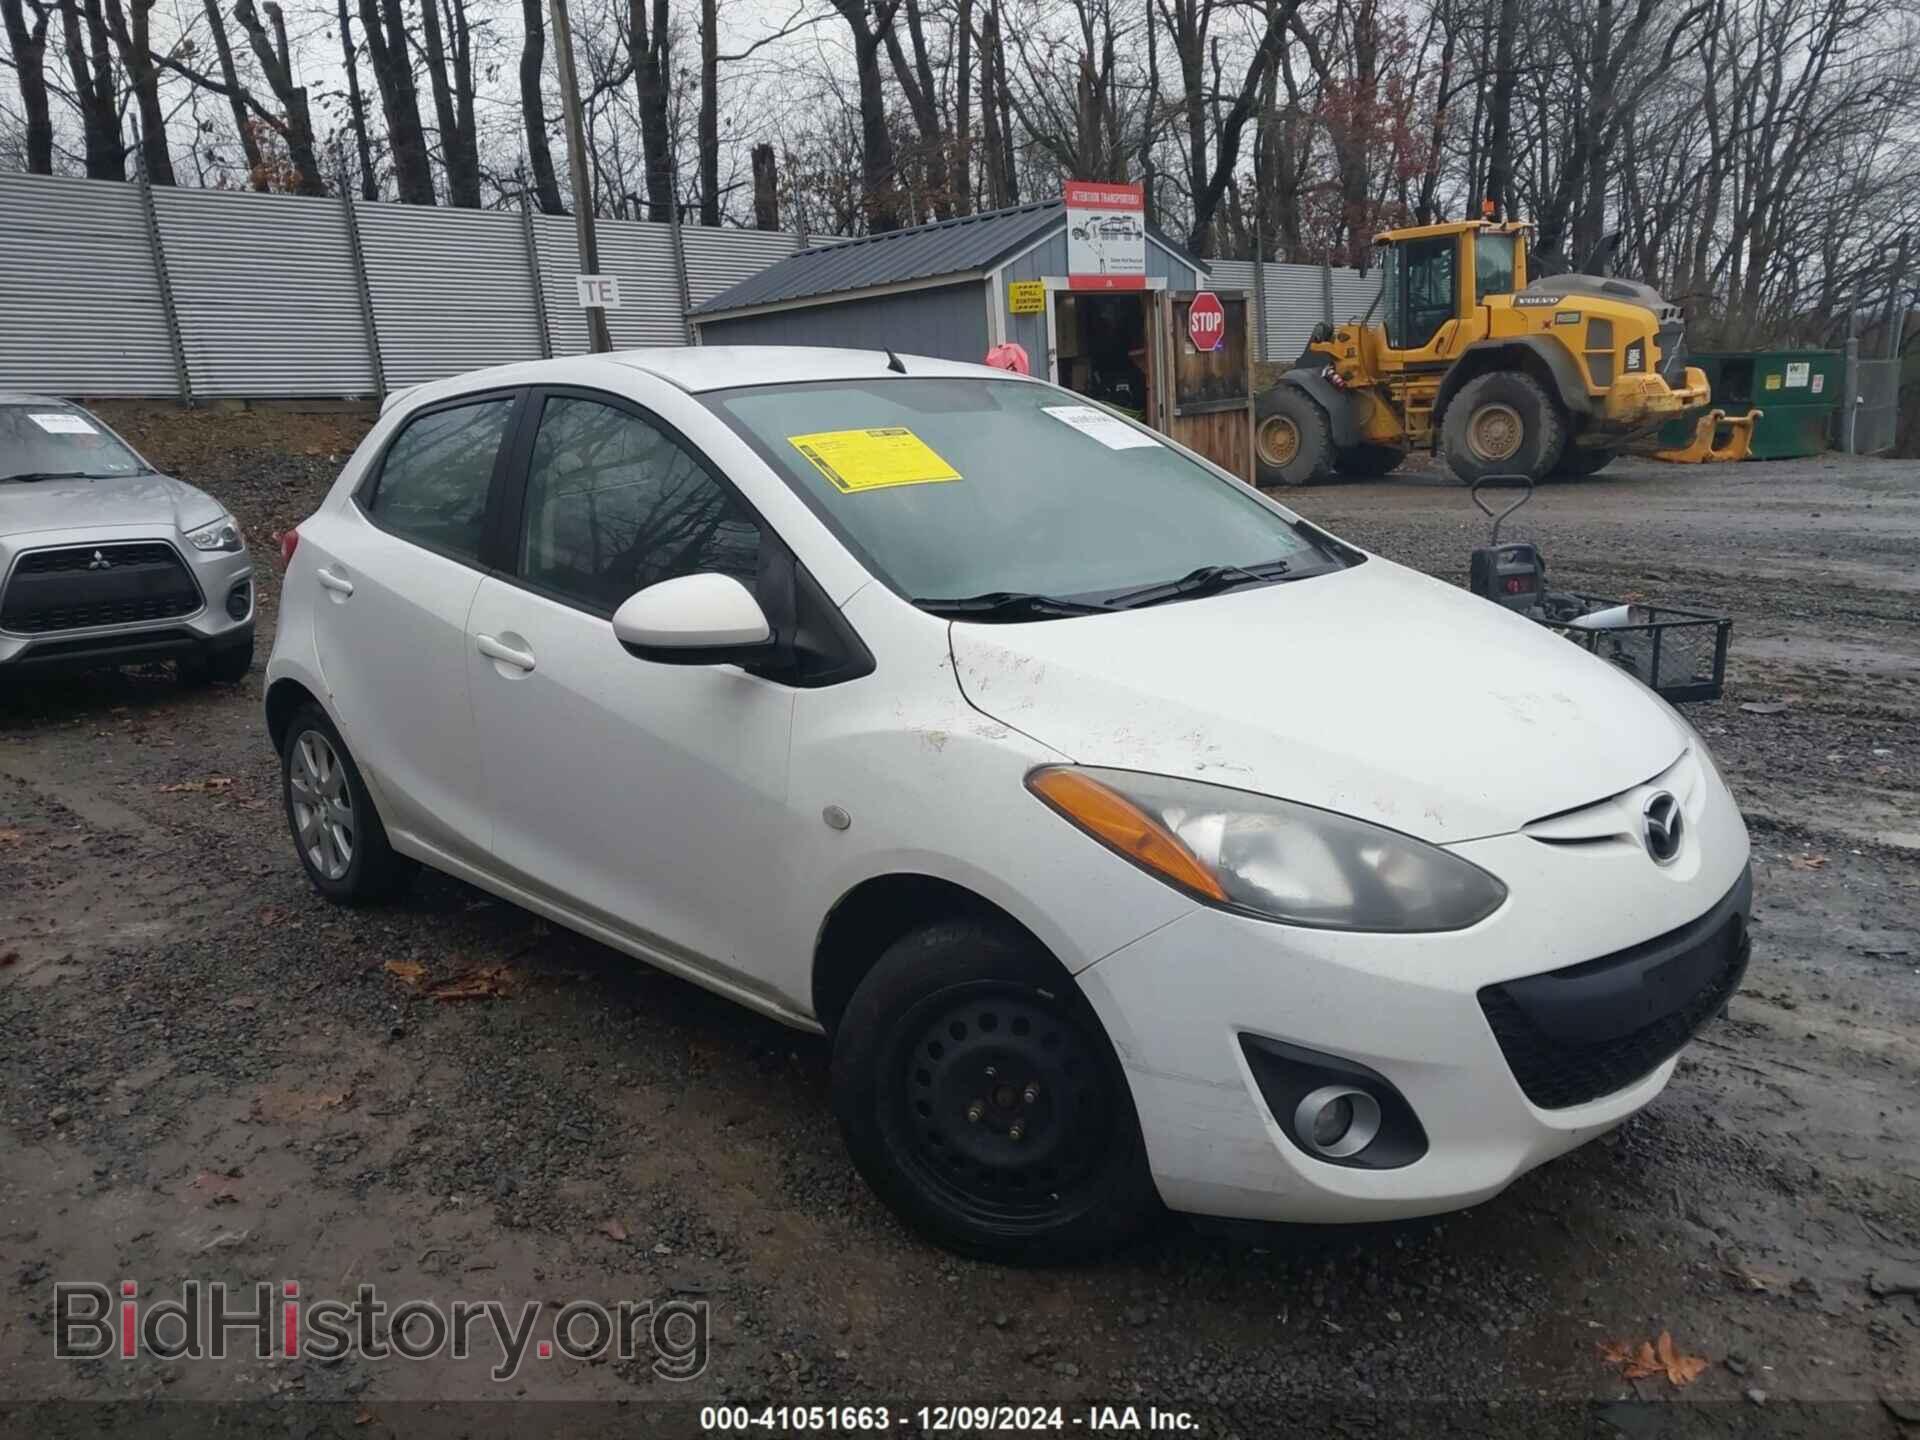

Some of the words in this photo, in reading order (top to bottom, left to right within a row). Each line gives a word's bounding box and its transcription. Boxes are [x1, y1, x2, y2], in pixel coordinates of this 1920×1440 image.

[582, 280, 614, 302] TE
[1519, 296, 1559, 305] VOLVO
[1191, 311, 1222, 333] STOP
